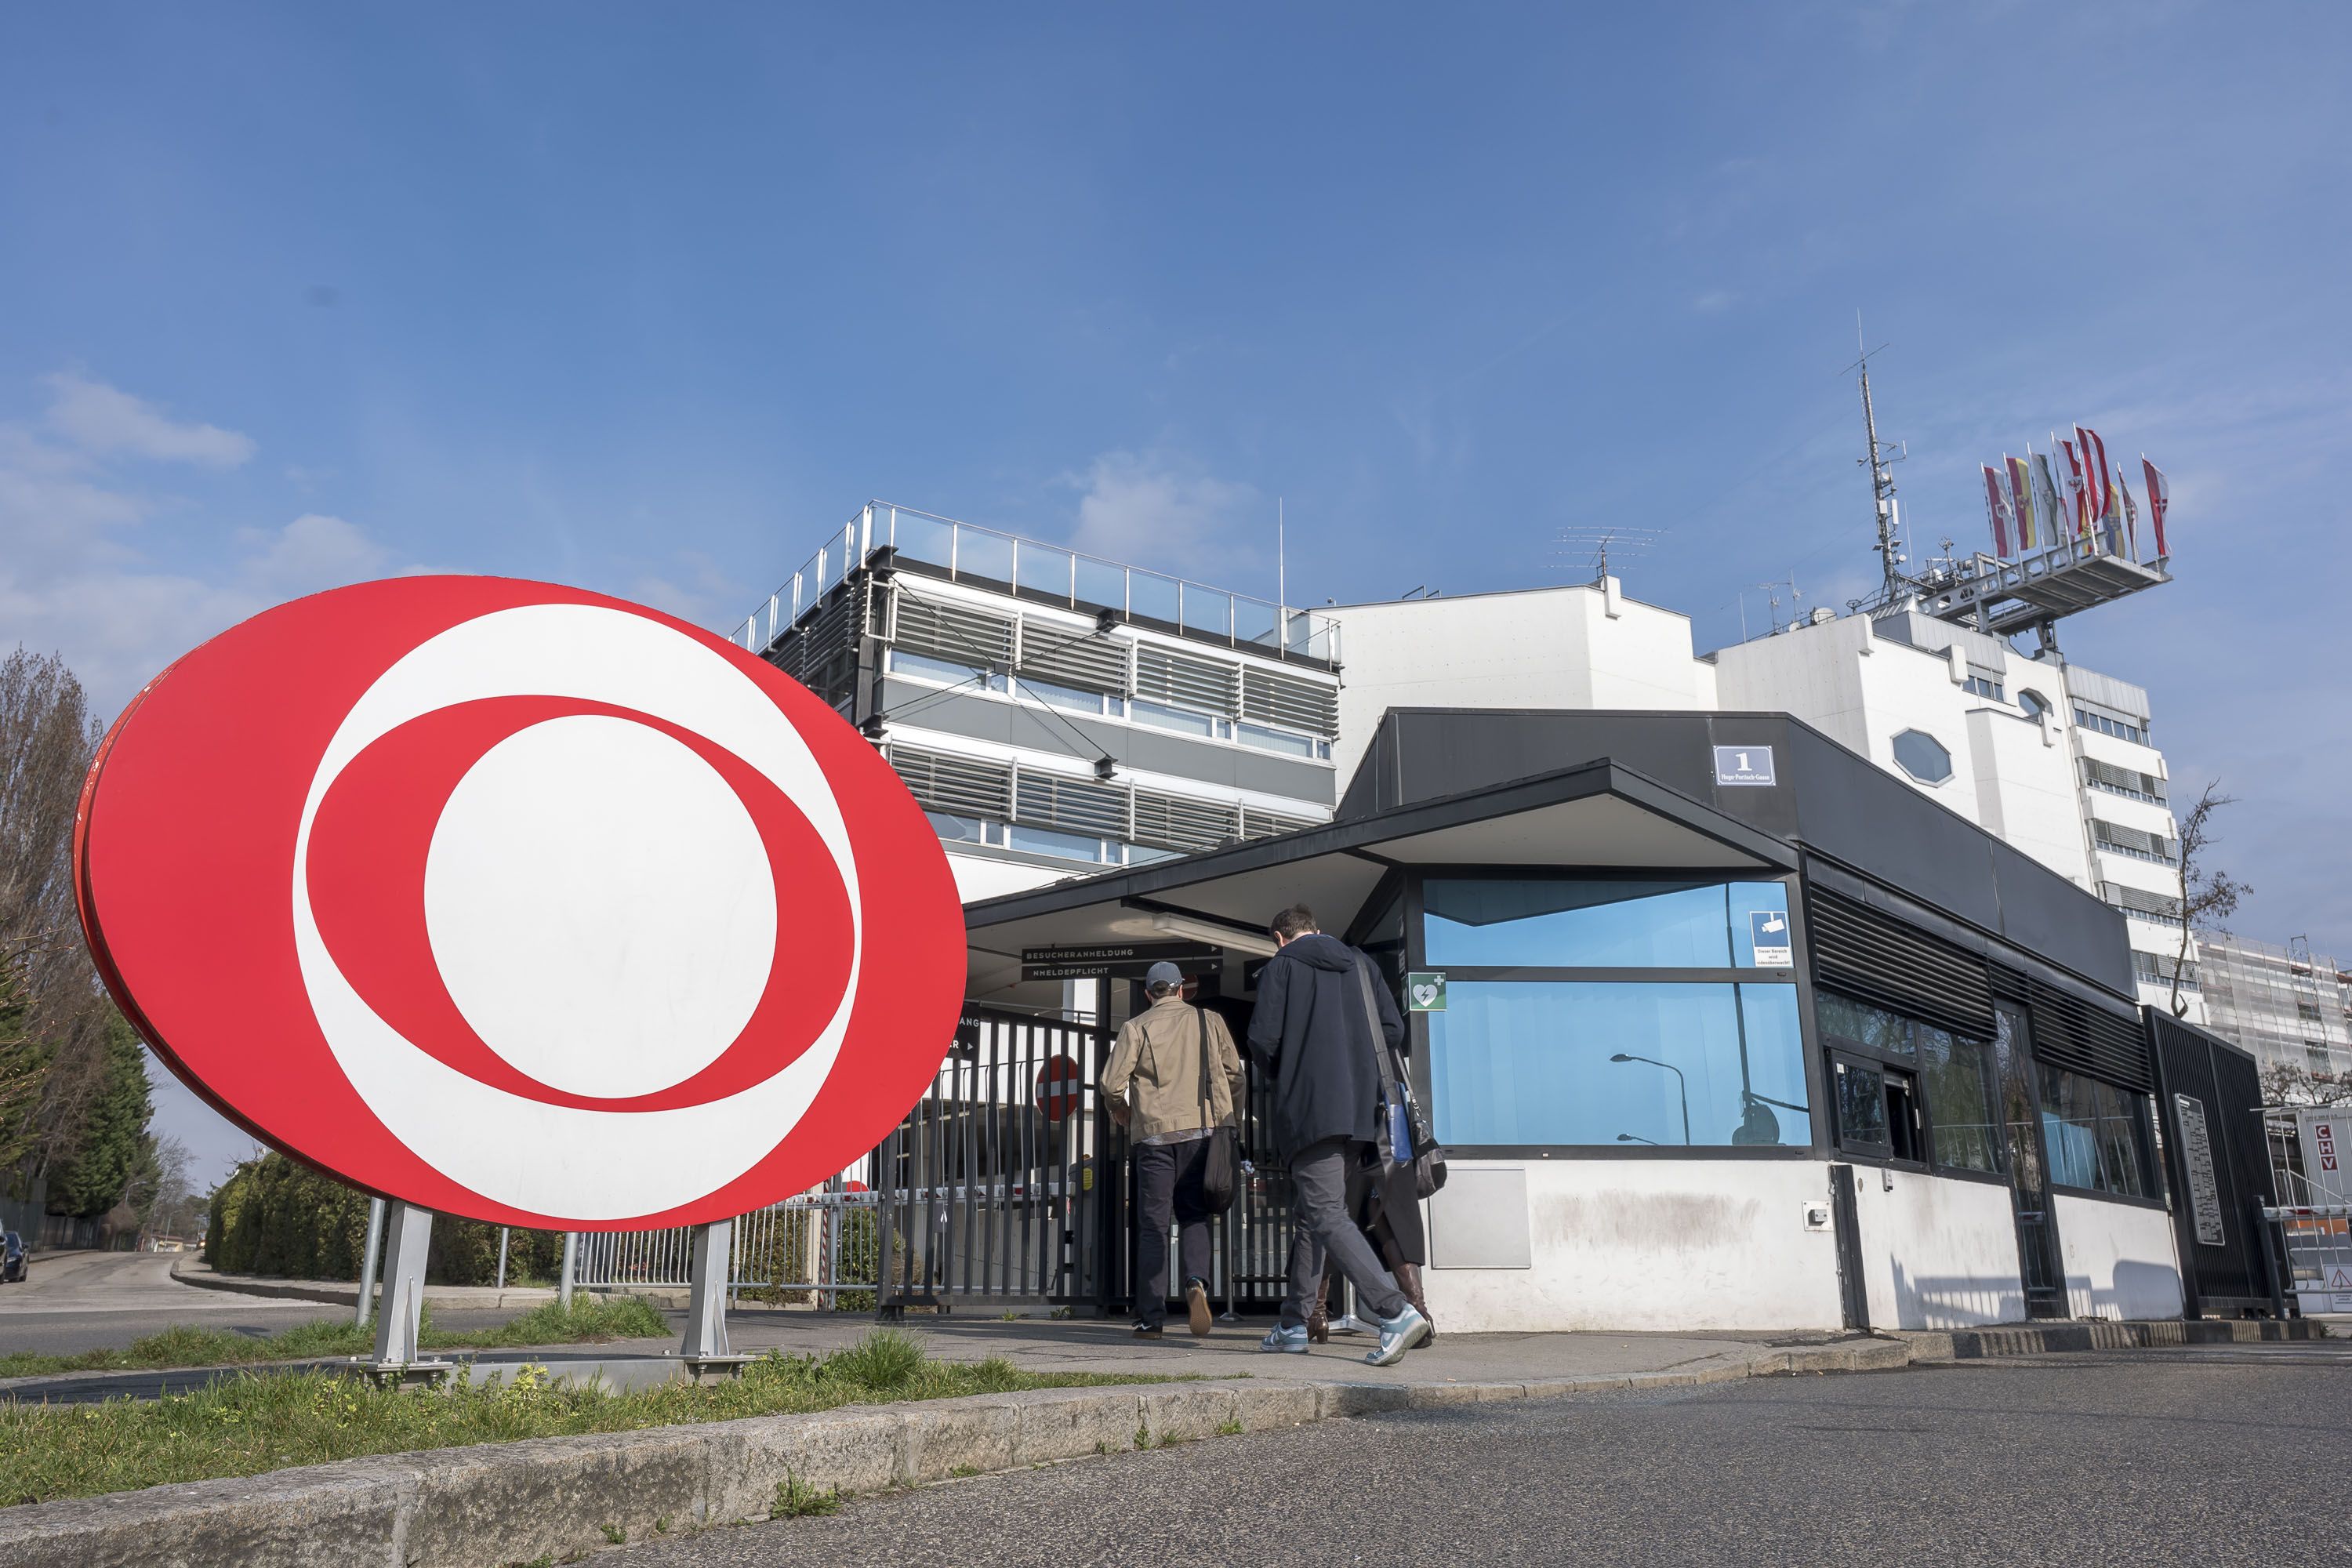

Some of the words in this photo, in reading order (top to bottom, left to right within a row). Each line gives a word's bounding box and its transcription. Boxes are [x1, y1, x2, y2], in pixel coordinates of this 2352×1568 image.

[1735, 752, 1753, 771] 1
[1721, 773, 1770, 782] Hugo-Portisch-Gasse
[1026, 949, 1134, 960] BESUCHERANMELDUNG
[2318, 1127, 2333, 1169] CHV
